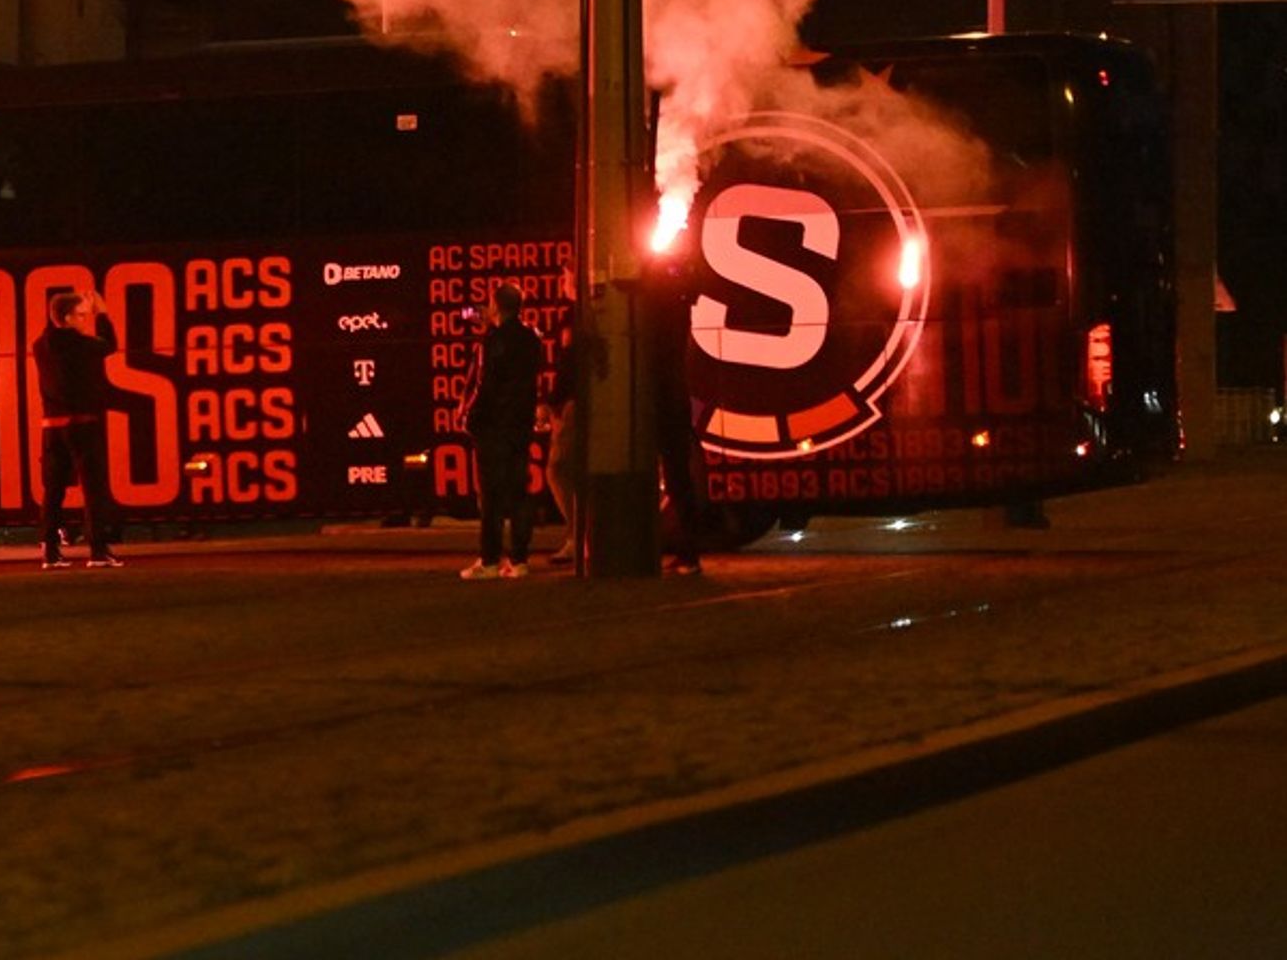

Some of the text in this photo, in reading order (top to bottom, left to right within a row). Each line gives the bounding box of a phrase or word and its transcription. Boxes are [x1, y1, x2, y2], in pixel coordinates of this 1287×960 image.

[429, 241, 572, 271] AC SPARTA
[186, 256, 292, 311] ACS
[343, 264, 401, 280] BETANO
[692, 183, 840, 369] S
[430, 277, 464, 304] AC
[431, 310, 465, 337] AC
[186, 321, 292, 376] ACS
[432, 342, 466, 369] AC
[433, 374, 466, 401] AC
[187, 387, 294, 442] ACS
[190, 450, 298, 504] ACS
[348, 466, 388, 484] PRE
[707, 470, 820, 502] CS1893
